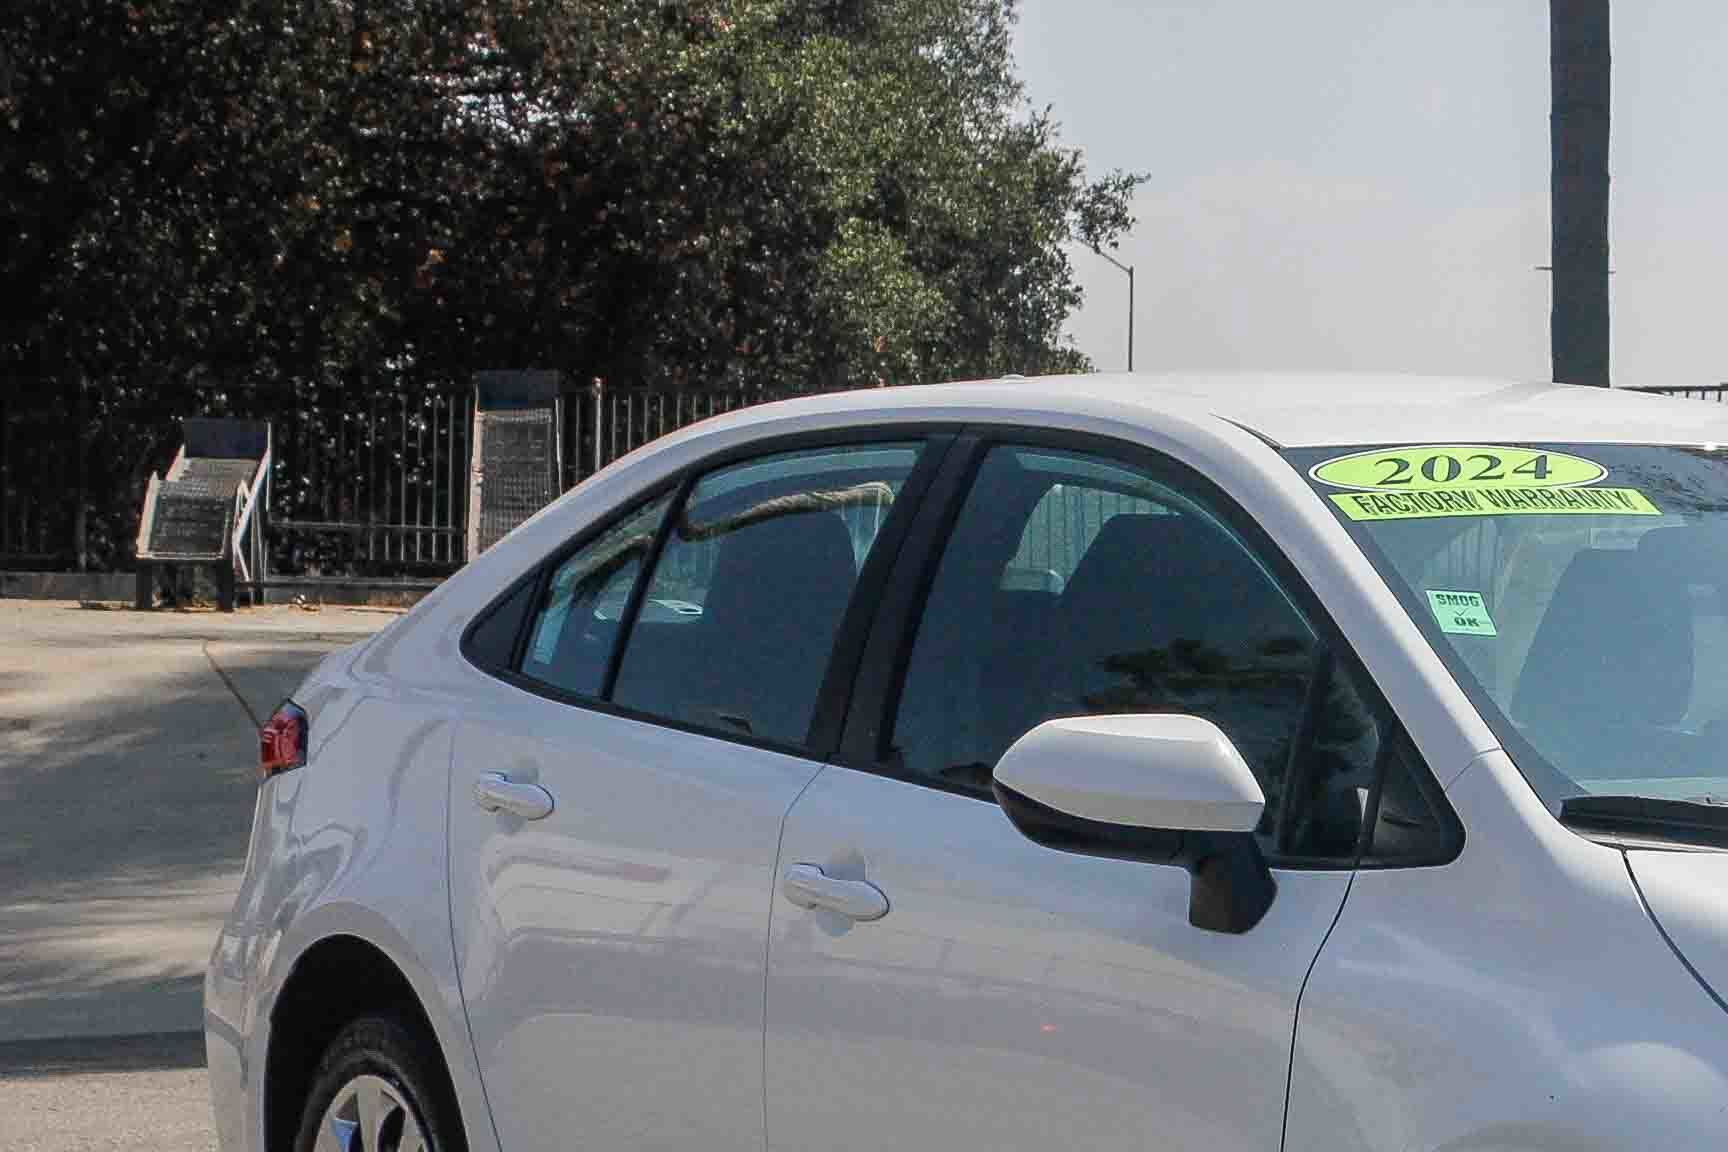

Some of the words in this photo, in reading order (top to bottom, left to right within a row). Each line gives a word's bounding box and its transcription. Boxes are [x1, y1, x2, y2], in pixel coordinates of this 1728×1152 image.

[1374, 454, 1553, 486] 2024
[1351, 489, 1481, 514] FACTORY
[1477, 487, 1636, 510] WARRANTY
[1435, 593, 1481, 607] SMOG
[1454, 616, 1480, 627] OK
